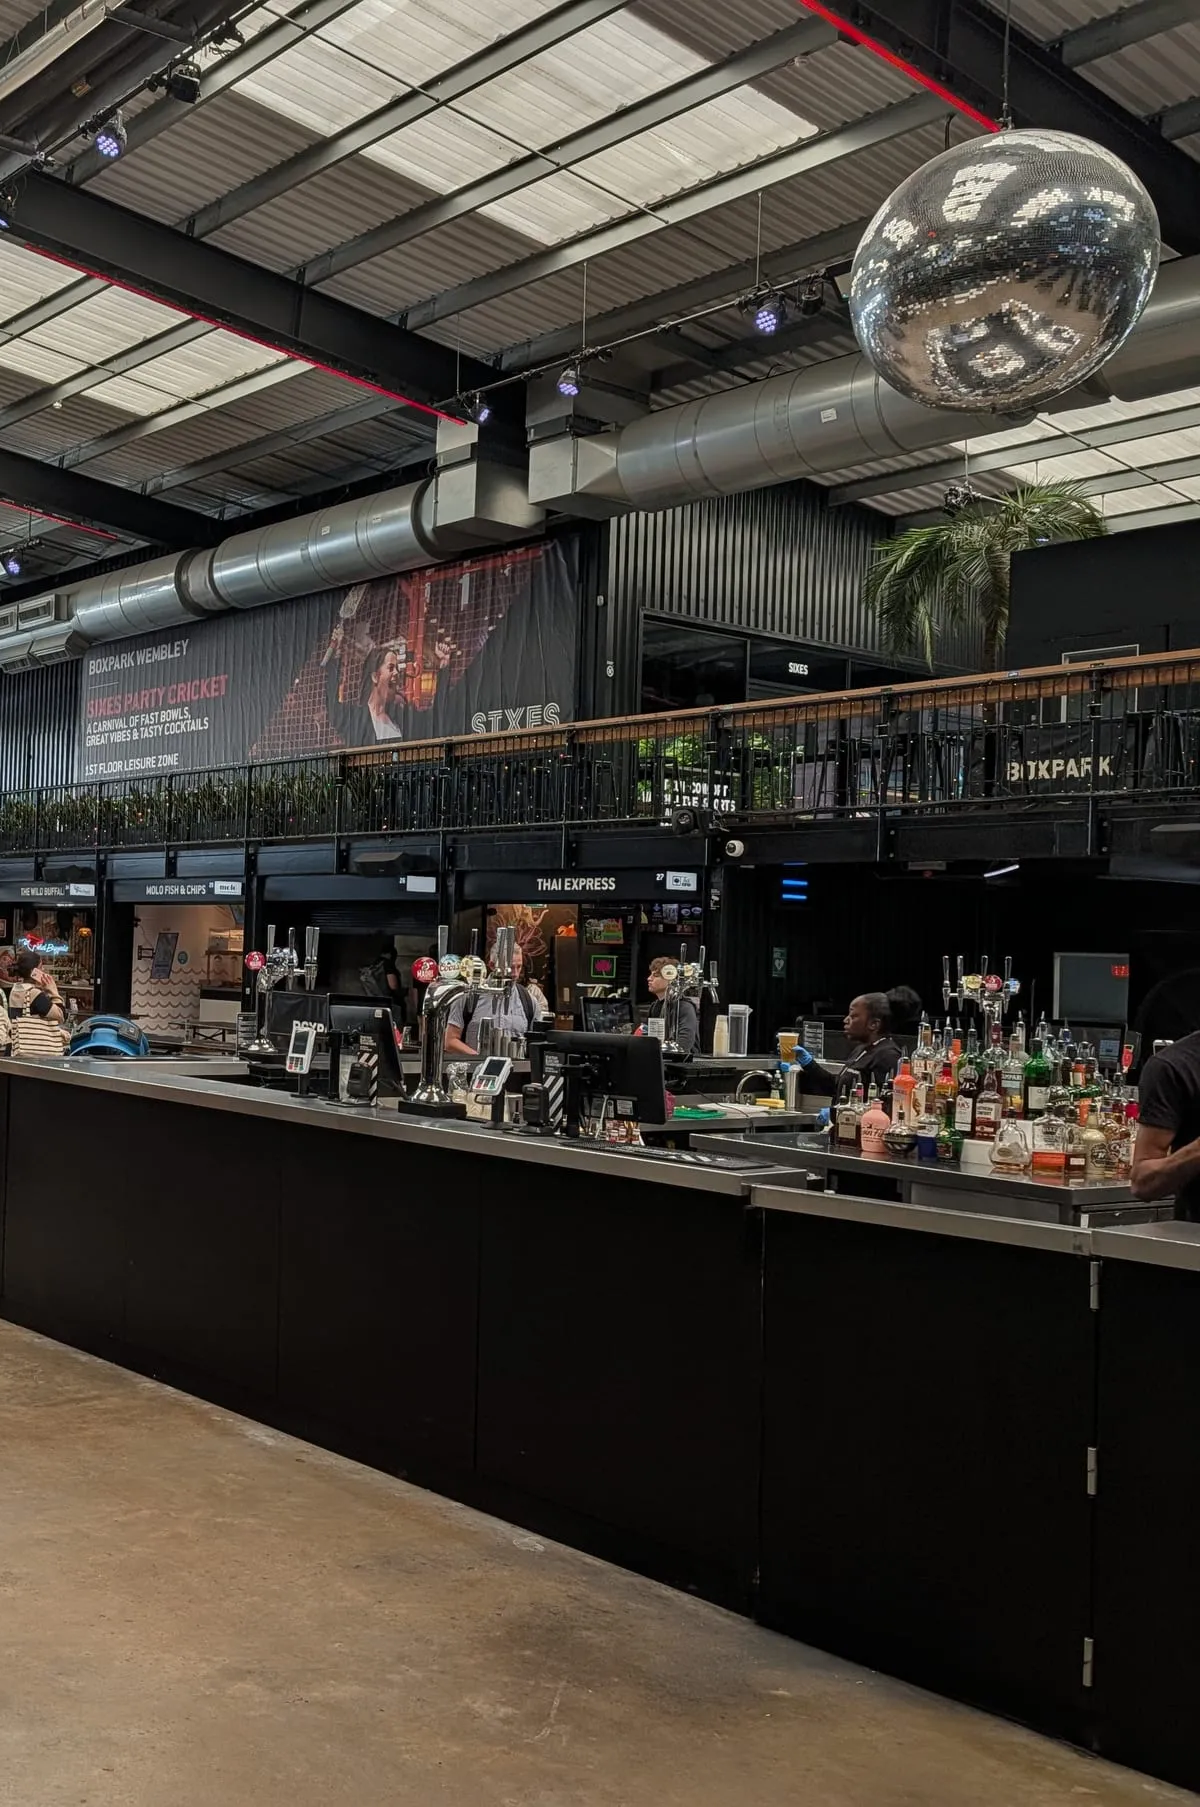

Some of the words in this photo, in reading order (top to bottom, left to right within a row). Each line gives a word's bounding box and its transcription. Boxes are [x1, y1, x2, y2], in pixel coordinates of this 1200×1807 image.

[89, 651, 135, 675] BOXPARK
[136, 638, 190, 665] WEMBLEY
[788, 661, 809, 675] SIXES
[87, 694, 122, 718] SIXES
[124, 686, 166, 712] PARTY
[167, 674, 229, 705] CRICKET
[86, 723, 92, 734] A
[92, 717, 128, 734] CARNIVAL
[129, 715, 140, 727] OF
[140, 711, 160, 725] FAST
[160, 706, 192, 723] BOWLS,
[86, 733, 109, 747] GREAT
[110, 730, 131, 744] VIBES
[132, 729, 139, 740] &
[140, 725, 163, 739] TASTY
[164, 716, 209, 735] COCKTAILS
[85, 764, 98, 776] 1ST
[98, 760, 123, 775] FLOOR
[124, 756, 156, 771] LEISURE
[158, 753, 179, 767] ZONE
[537, 878, 562, 891] THAI
[564, 877, 616, 891] EXPRESS
[656, 873, 665, 881] 27
[21, 887, 30, 896] THE
[31, 887, 43, 896] WILD
[146, 885, 164, 895] MOLO
[164, 885, 179, 895] FISH
[180, 884, 186, 894] &
[186, 884, 206, 895] CHIPS
